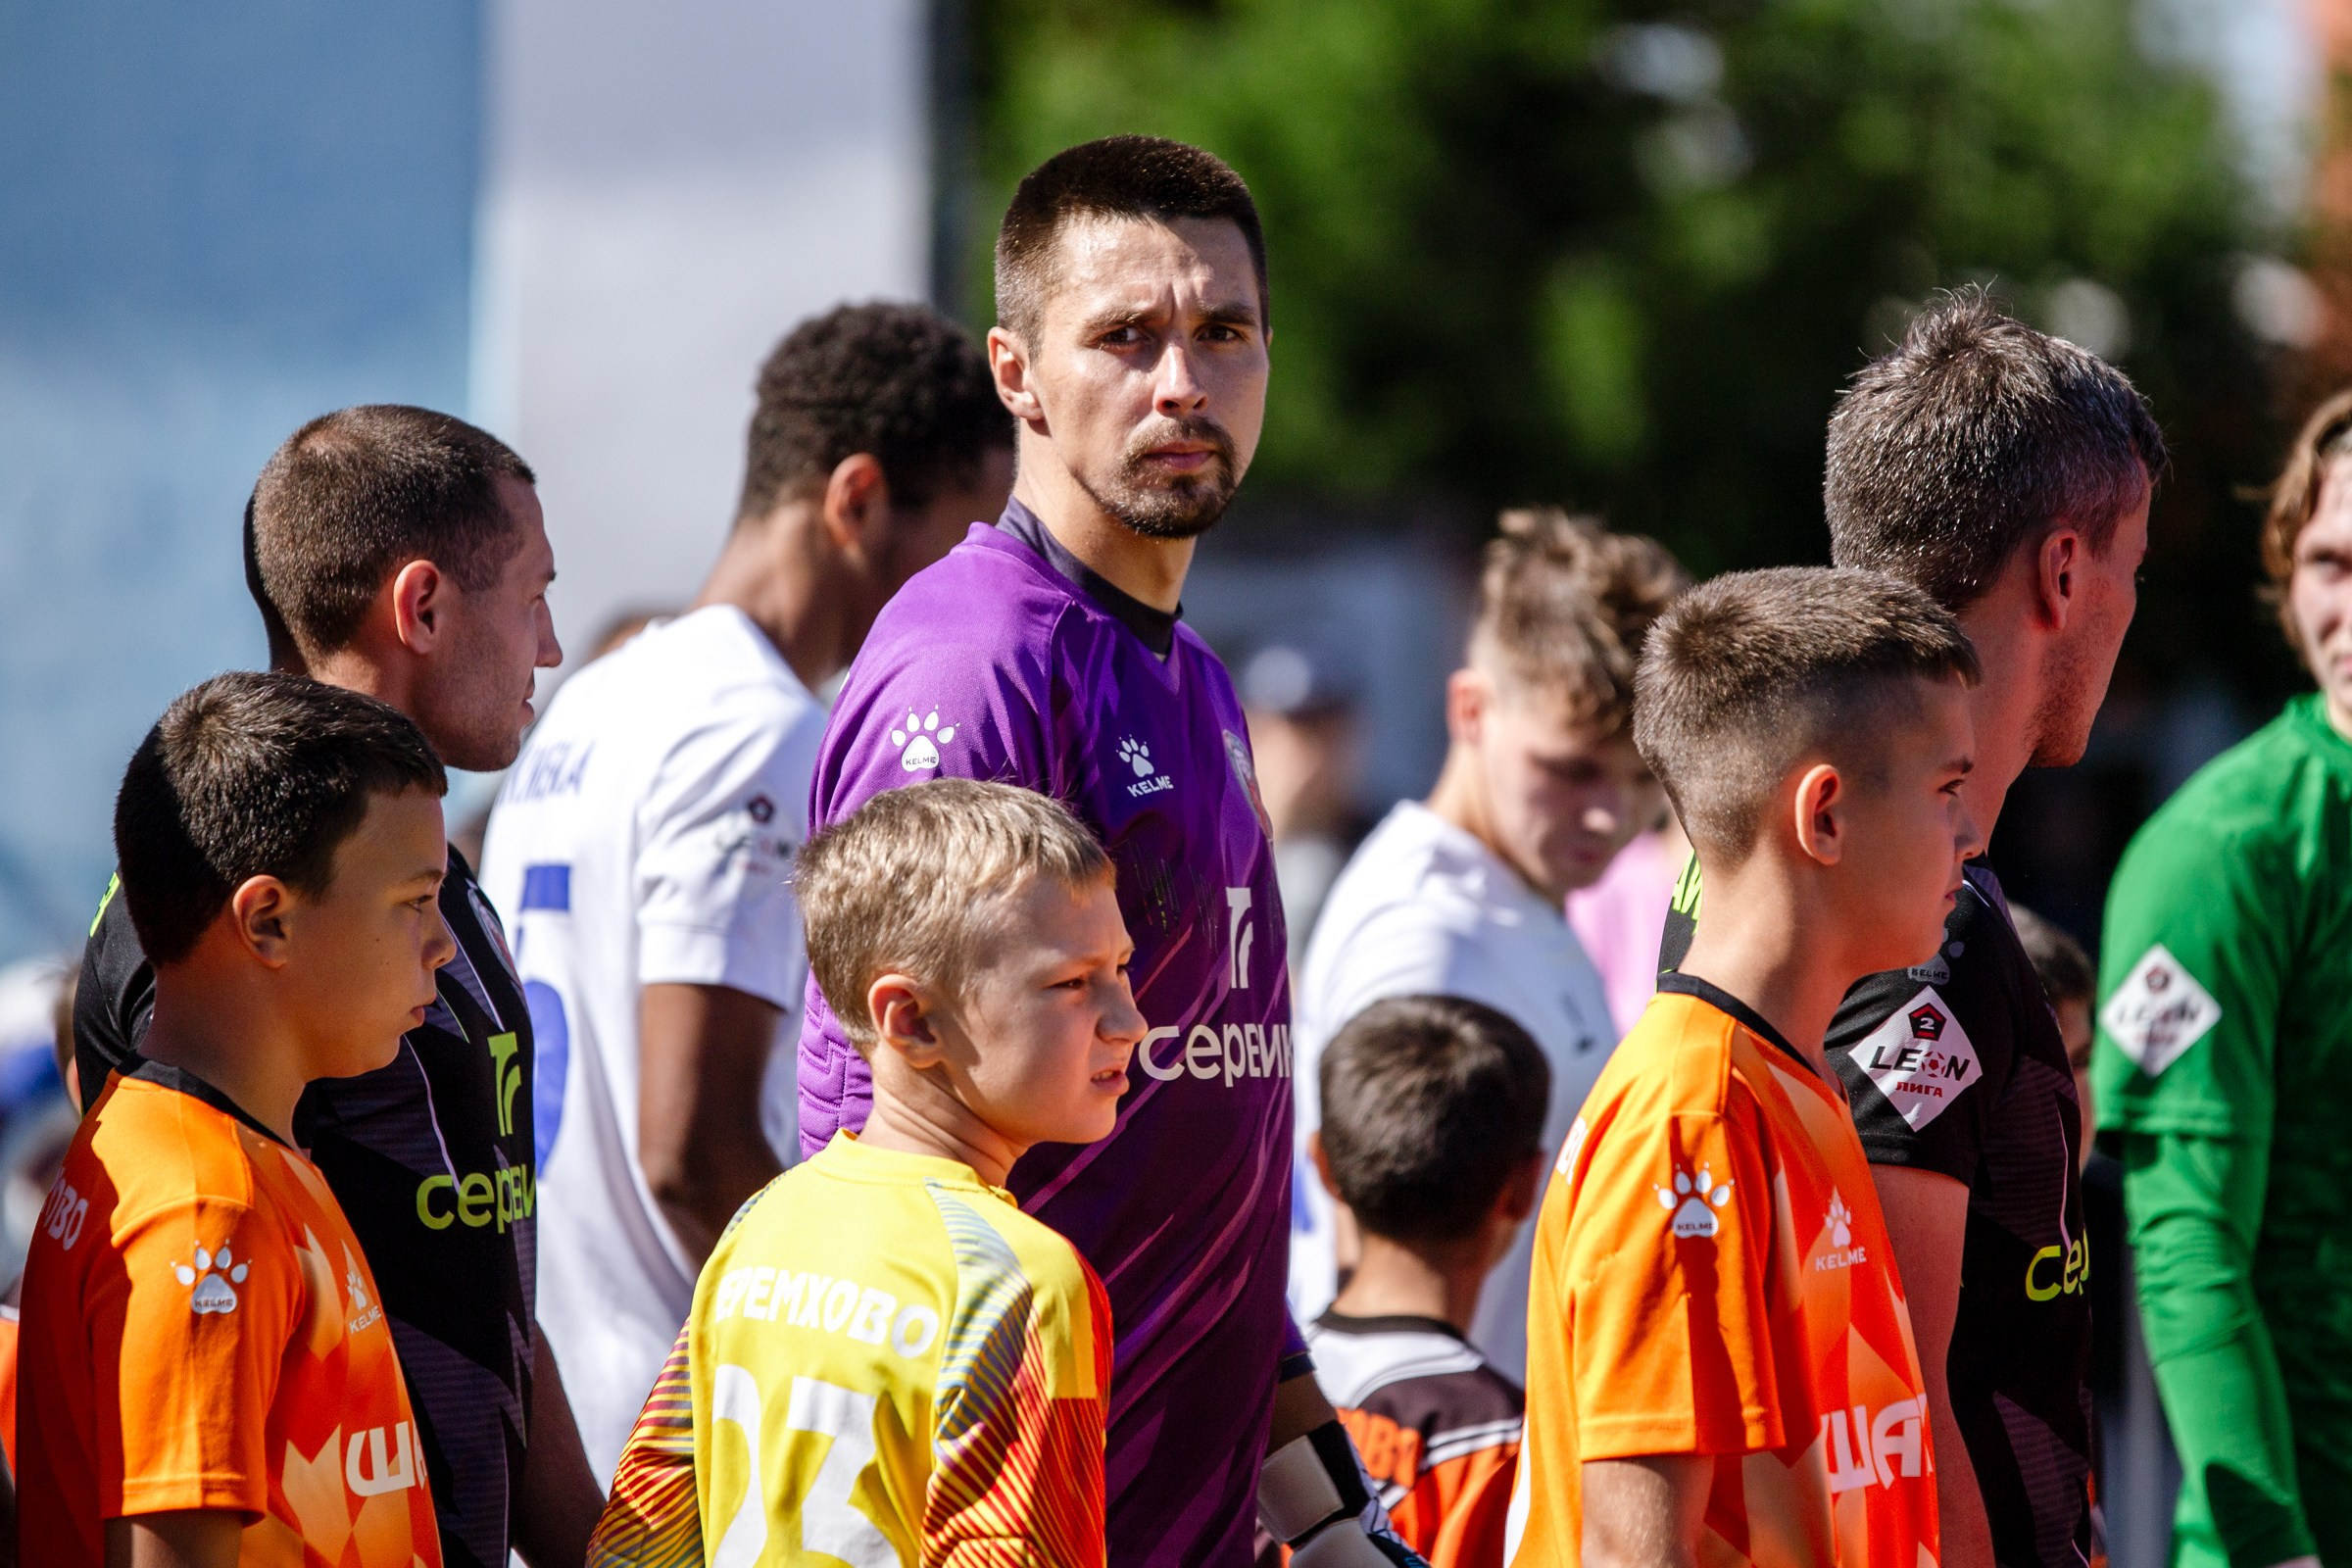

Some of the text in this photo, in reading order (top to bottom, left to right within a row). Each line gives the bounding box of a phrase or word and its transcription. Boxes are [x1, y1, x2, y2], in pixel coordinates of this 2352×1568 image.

[906, 757, 937, 765] KELME
[1127, 775, 1174, 797] KELME
[1920, 1017, 1936, 1030] 2
[1869, 1046, 1971, 1082] LEON
[1895, 1081, 1943, 1098] ЛИГА
[1815, 1247, 1867, 1272] KELME
[195, 1298, 233, 1307] KELME
[349, 1304, 381, 1334] KELME
